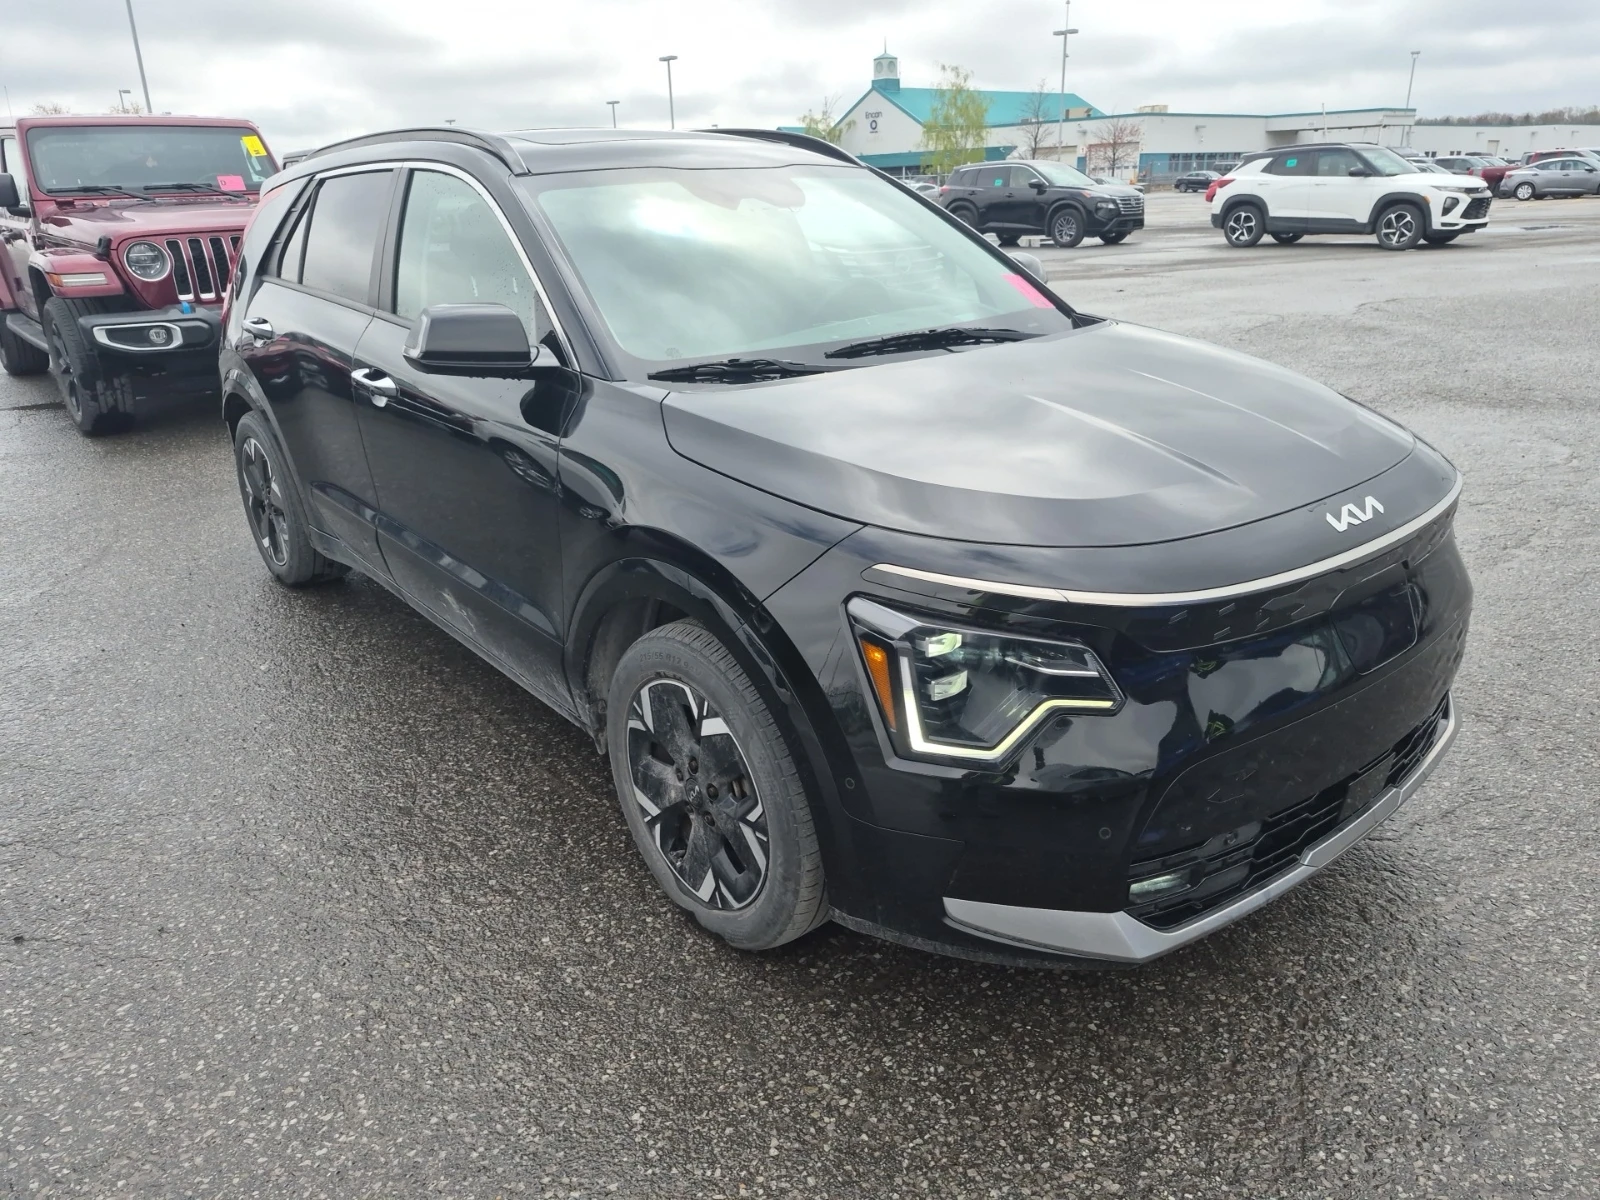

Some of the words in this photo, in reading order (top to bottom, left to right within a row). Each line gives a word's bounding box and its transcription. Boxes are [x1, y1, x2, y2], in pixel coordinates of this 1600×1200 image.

[1326, 495, 1384, 532] KIA
[640, 651, 664, 661] 215/55
[665, 653, 681, 665] R17
